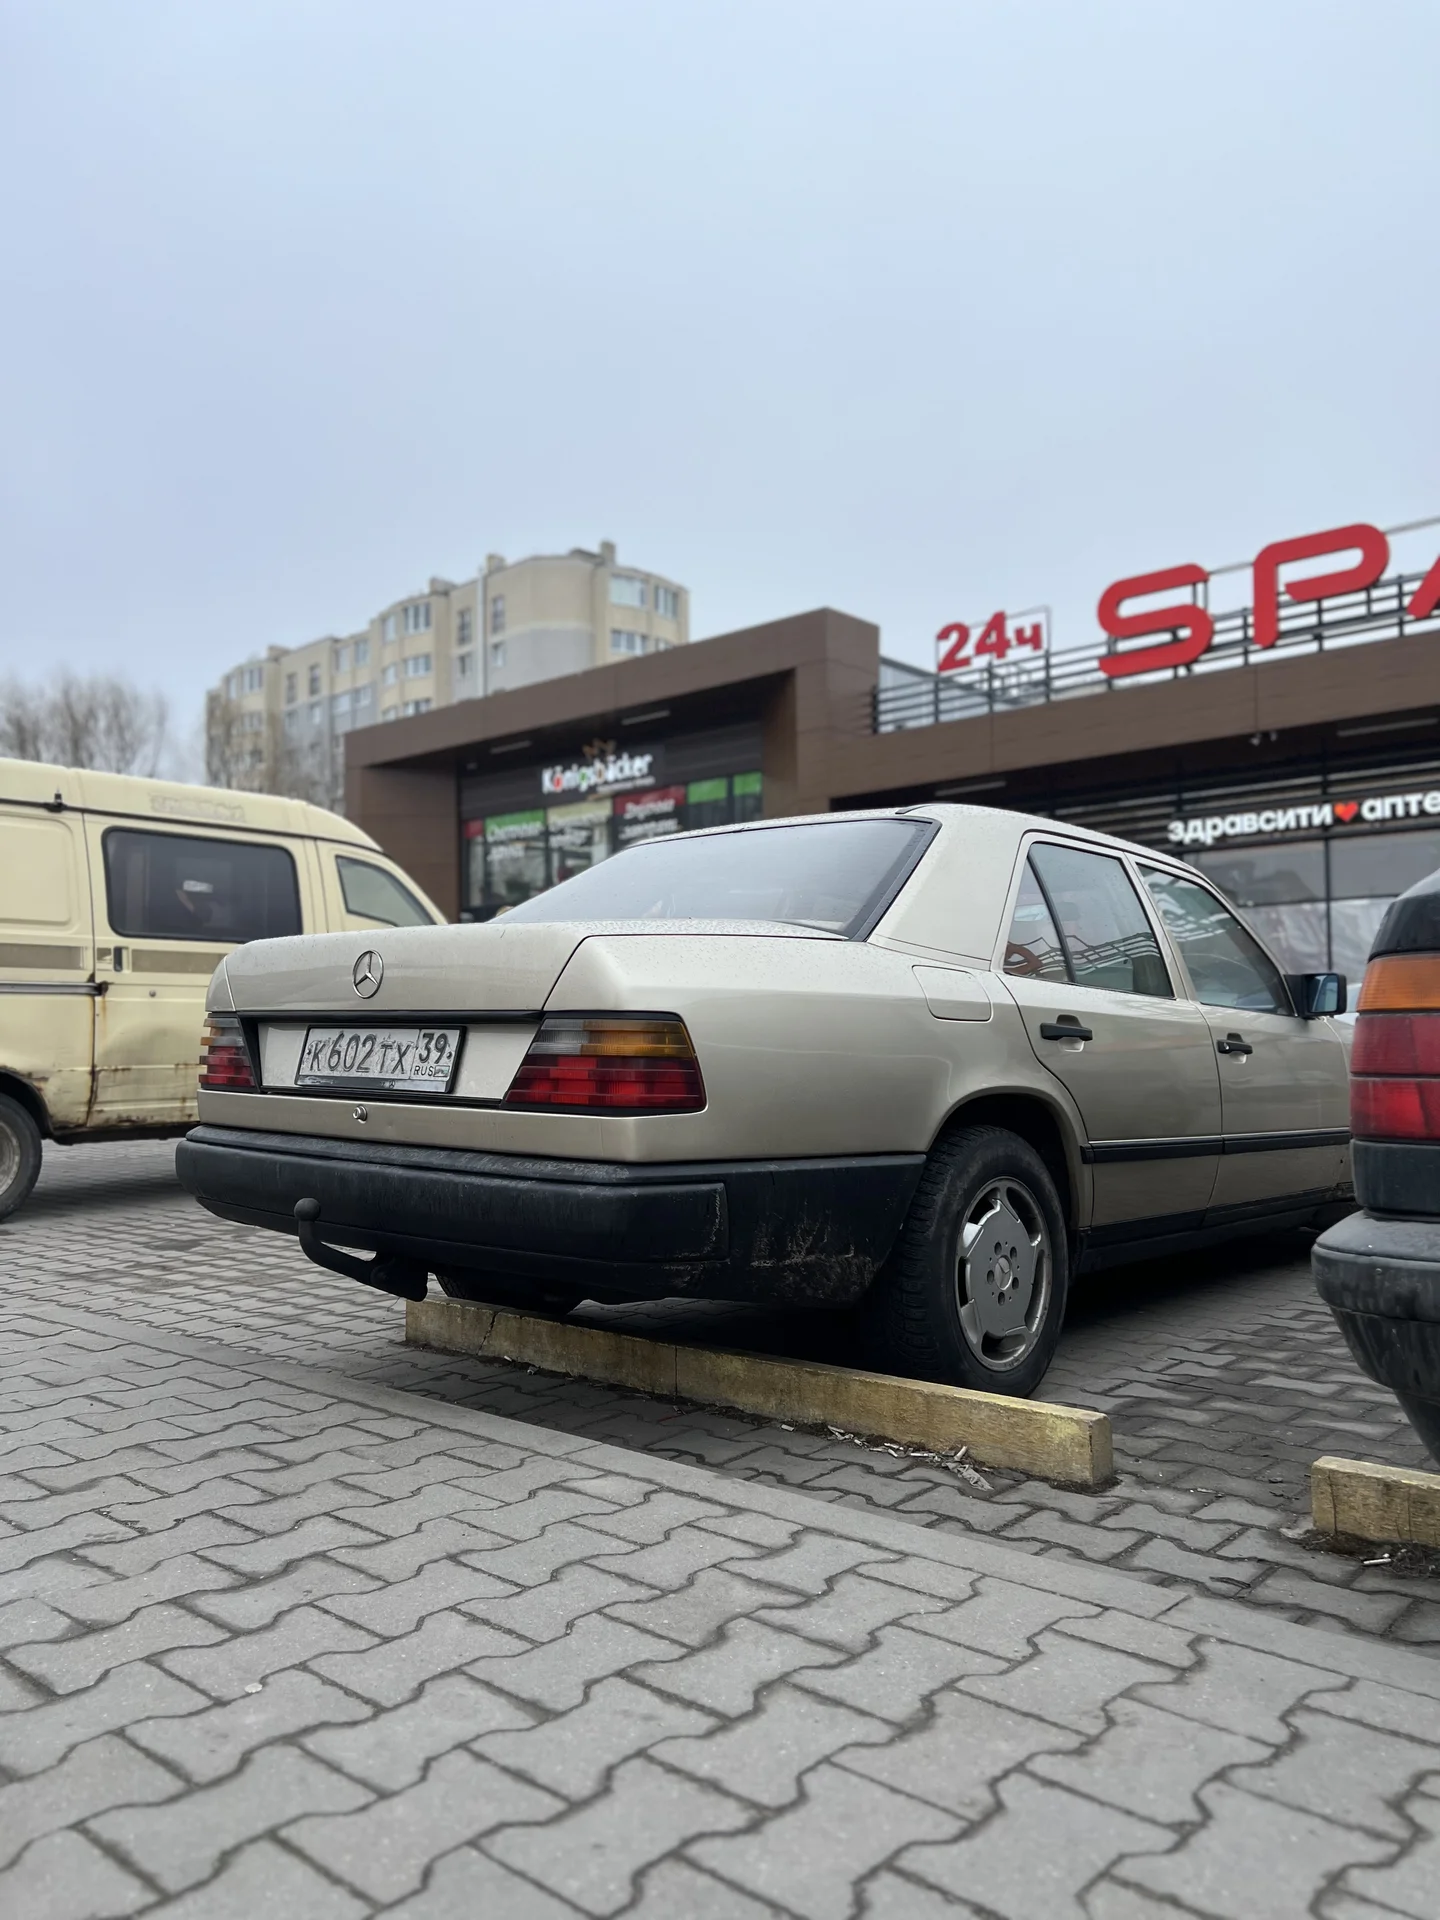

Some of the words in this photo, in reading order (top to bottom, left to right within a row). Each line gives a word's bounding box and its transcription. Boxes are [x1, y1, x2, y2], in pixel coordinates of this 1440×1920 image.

[936, 610, 1043, 673] 24ч
[1167, 803, 1333, 845] здравсити
[310, 1031, 411, 1074] К602ТХ
[418, 1032, 449, 1064] 39
[413, 1065, 434, 1077] RUS
